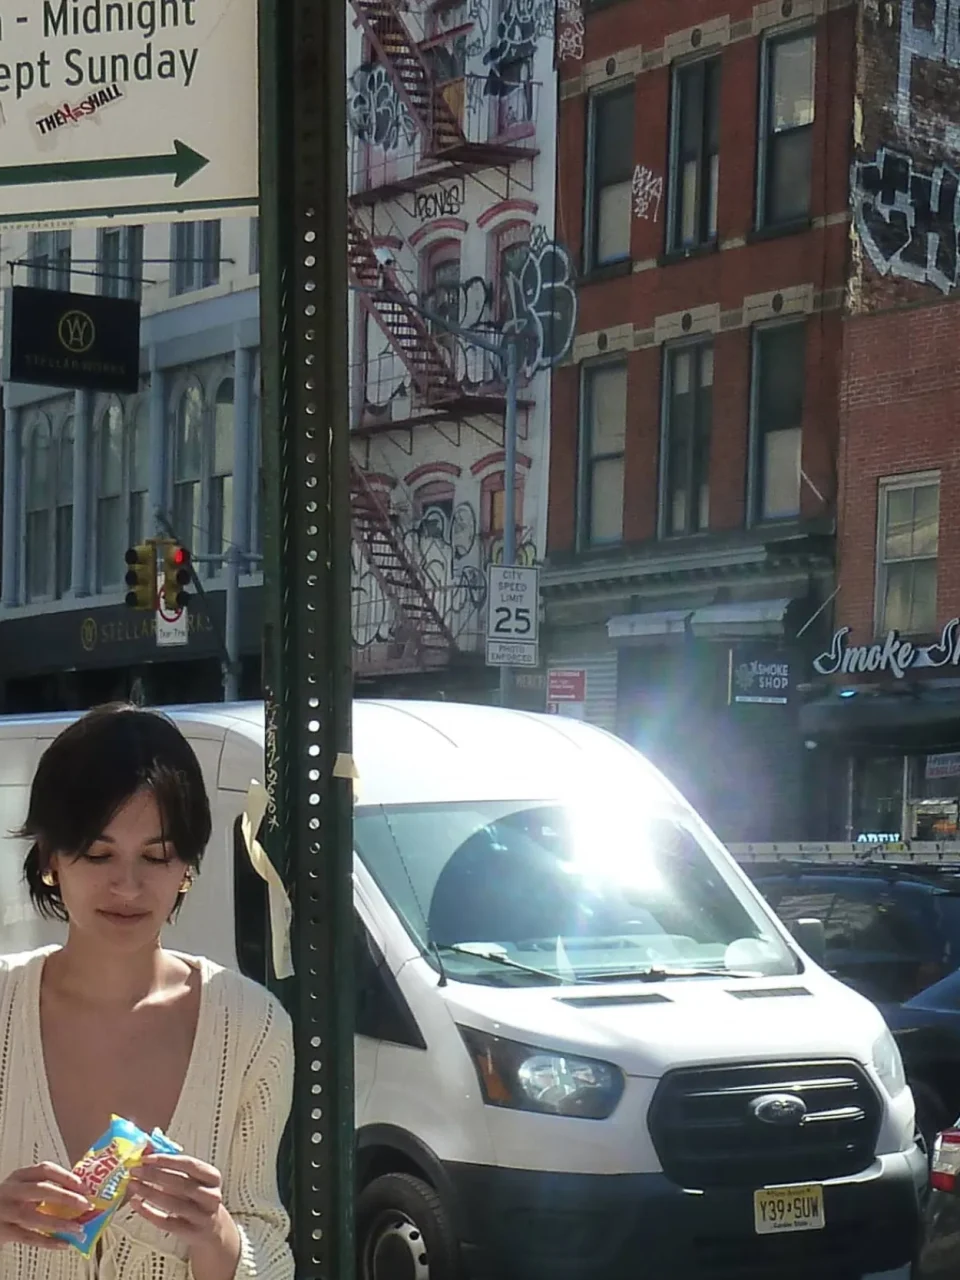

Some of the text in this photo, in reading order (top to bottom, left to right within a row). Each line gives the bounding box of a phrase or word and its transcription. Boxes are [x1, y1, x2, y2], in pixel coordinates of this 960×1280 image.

[43, 0, 196, 38] Midnight
[63, 43, 199, 87] Sunday
[502, 570, 523, 580] CITY
[498, 581, 527, 592] SPEED
[500, 593, 524, 603] LIMIT
[494, 606, 531, 634] 25
[812, 626, 916, 679] Smoke
[757, 663, 789, 676] SMOKE
[758, 676, 789, 689] SHOP
